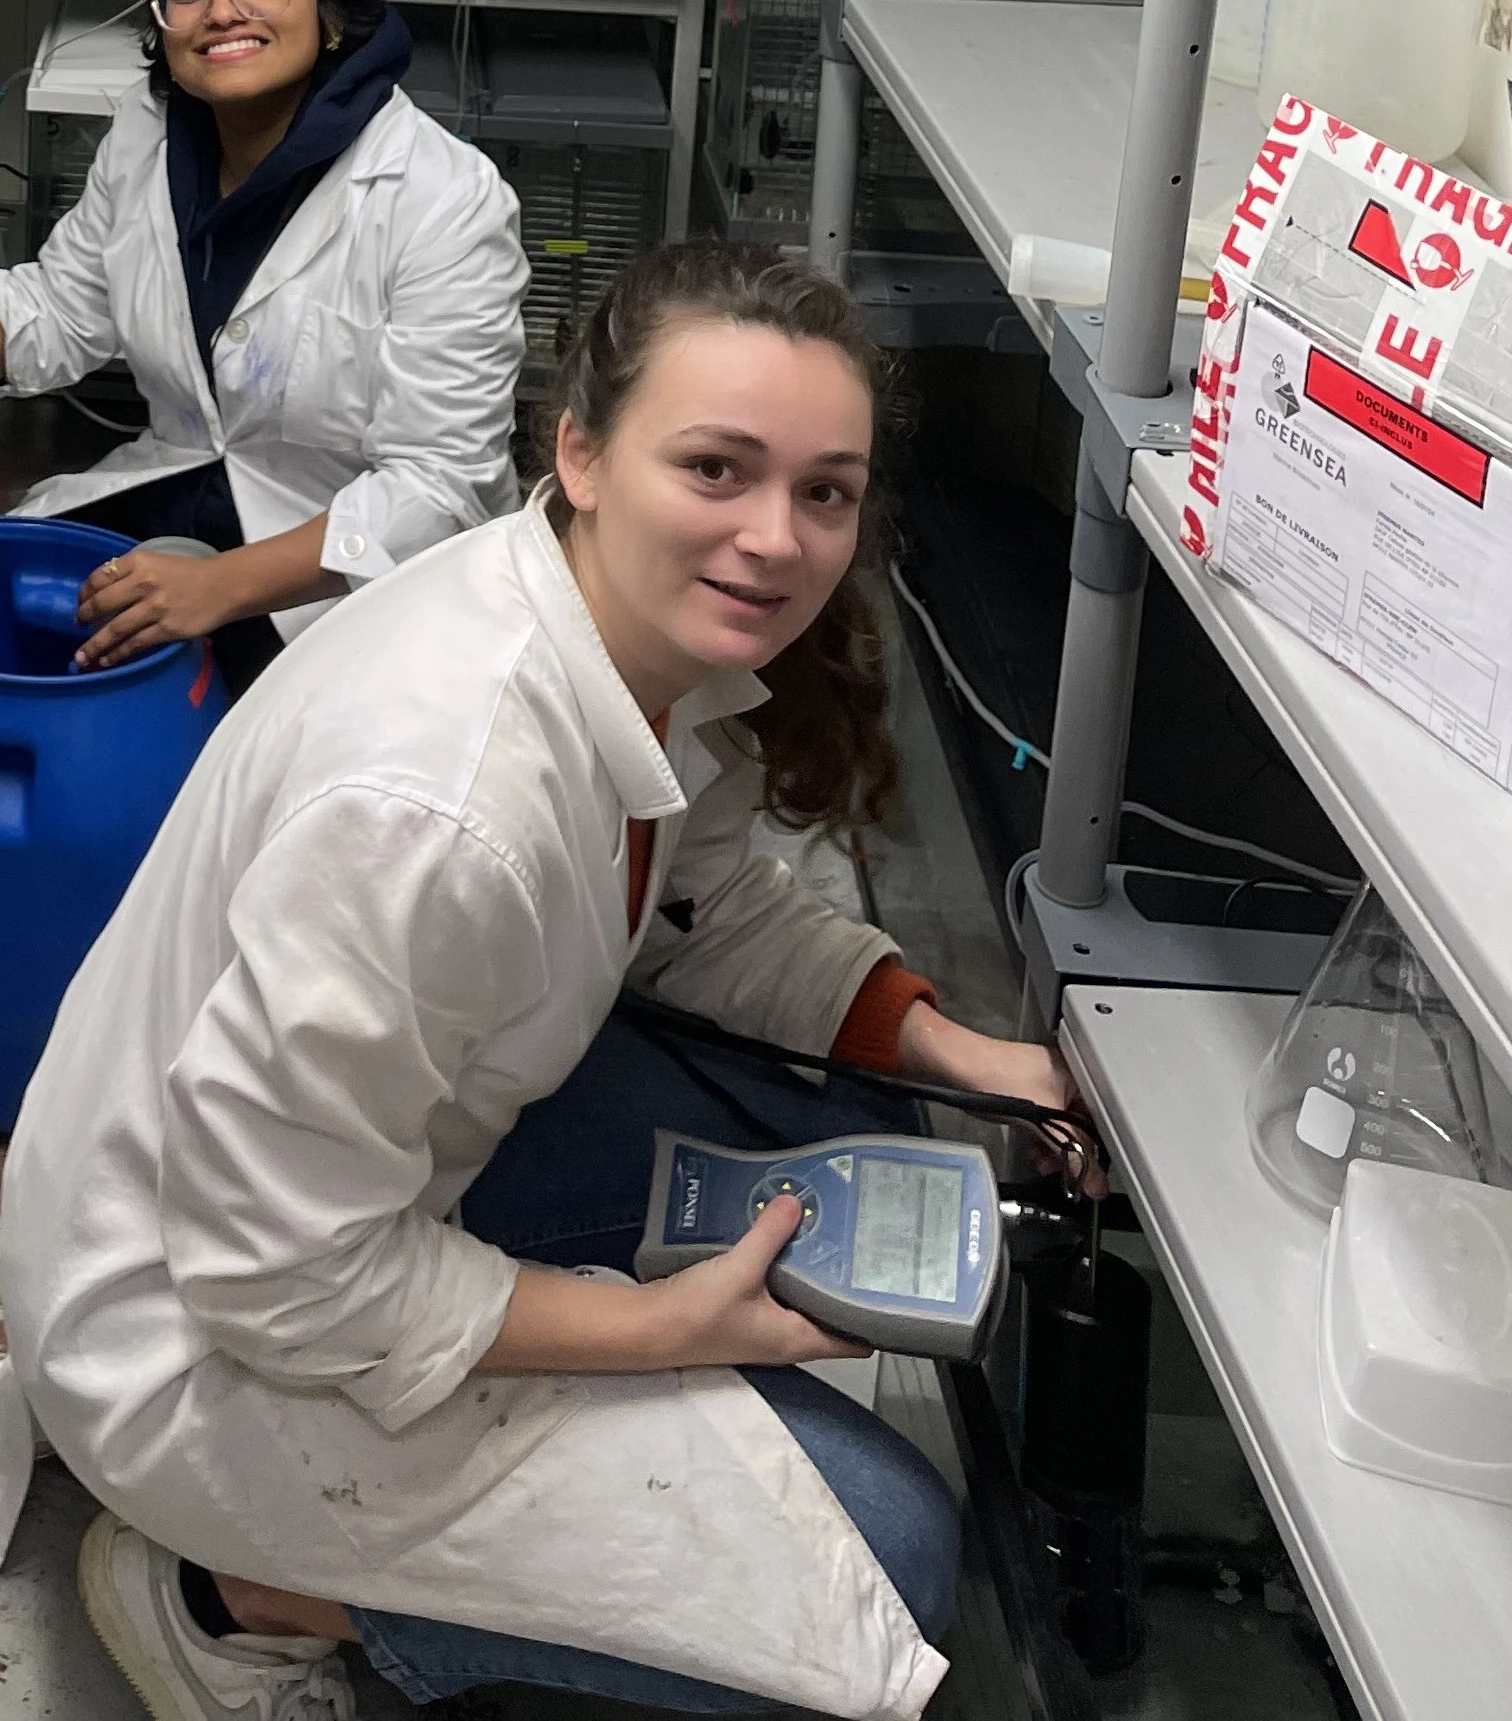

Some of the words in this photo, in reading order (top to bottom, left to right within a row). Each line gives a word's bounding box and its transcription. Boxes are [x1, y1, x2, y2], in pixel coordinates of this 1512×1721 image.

[1254, 406, 1348, 488] GREENSEA
[1355, 389, 1430, 444] DOCUMENTS
[1255, 493, 1274, 514] BON
[1275, 508, 1287, 525] DE
[1288, 519, 1340, 562] LIVRAISON
